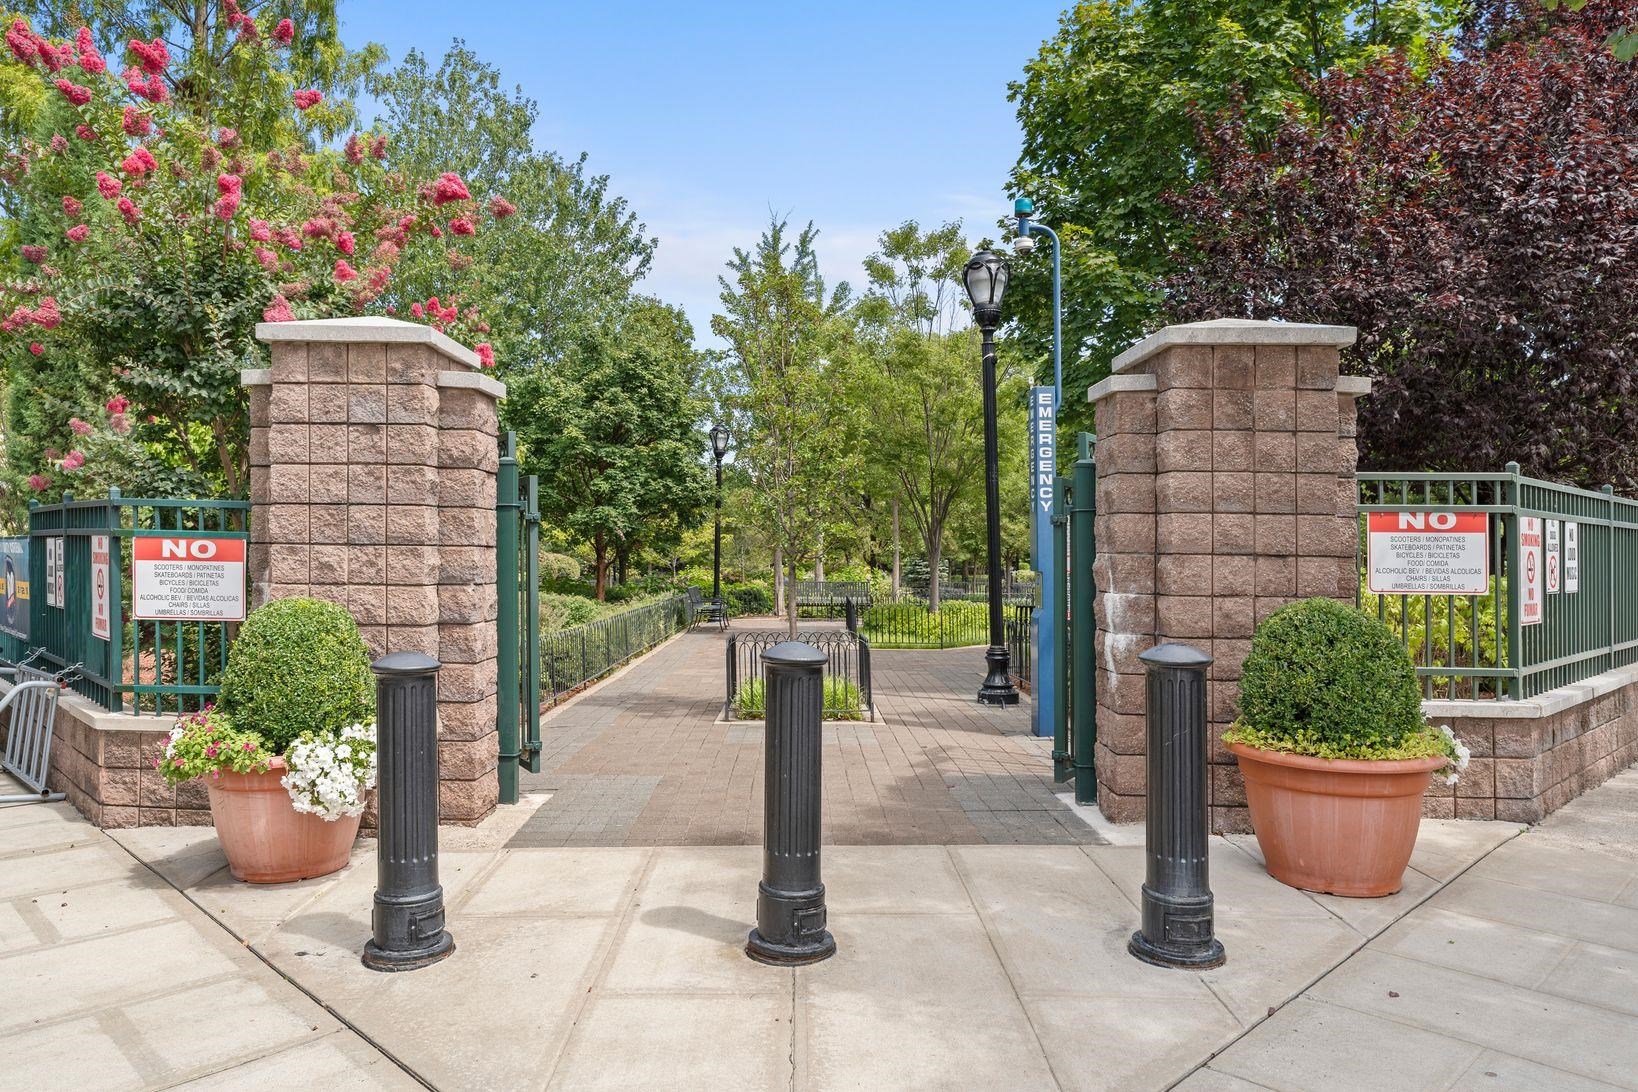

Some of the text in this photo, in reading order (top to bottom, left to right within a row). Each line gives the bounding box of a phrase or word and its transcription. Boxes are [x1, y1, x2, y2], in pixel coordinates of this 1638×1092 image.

[1038, 393, 1053, 512] EMERGENCY
[1399, 512, 1457, 530] NO
[162, 539, 217, 559] NO
